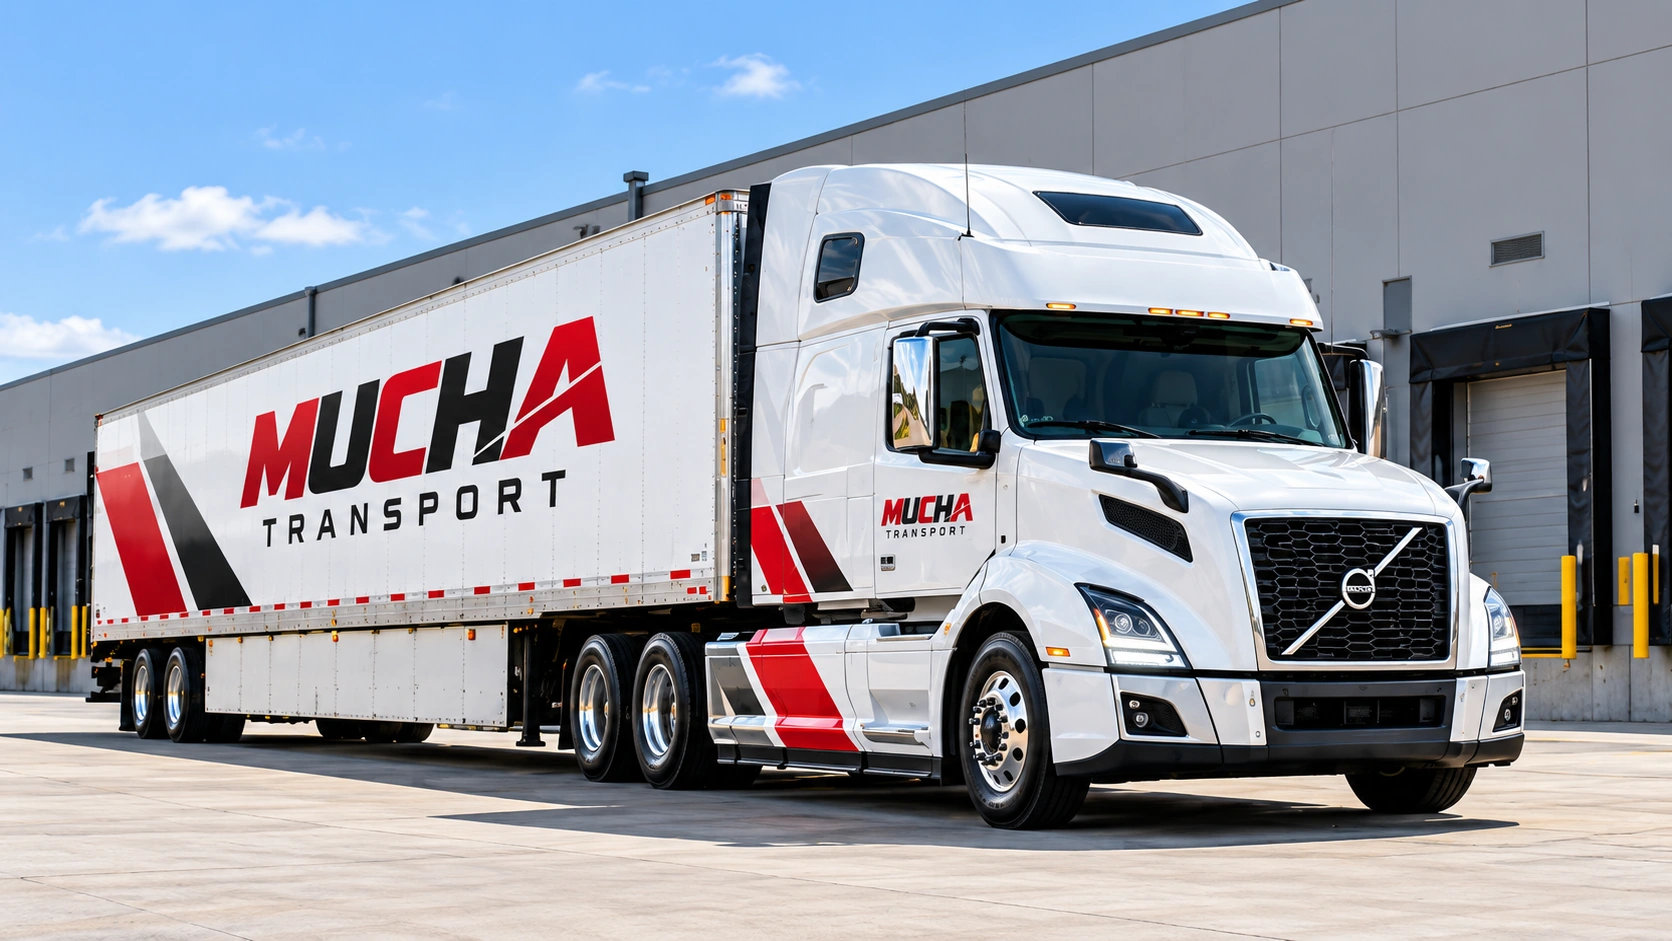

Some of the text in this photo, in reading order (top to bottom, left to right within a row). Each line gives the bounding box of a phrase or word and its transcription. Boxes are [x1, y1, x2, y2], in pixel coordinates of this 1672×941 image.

[240, 316, 615, 508] MUCHA
[262, 469, 566, 547] TRANSPORT
[881, 493, 973, 526] MUCHA
[886, 525, 965, 539] TRANSPORT
